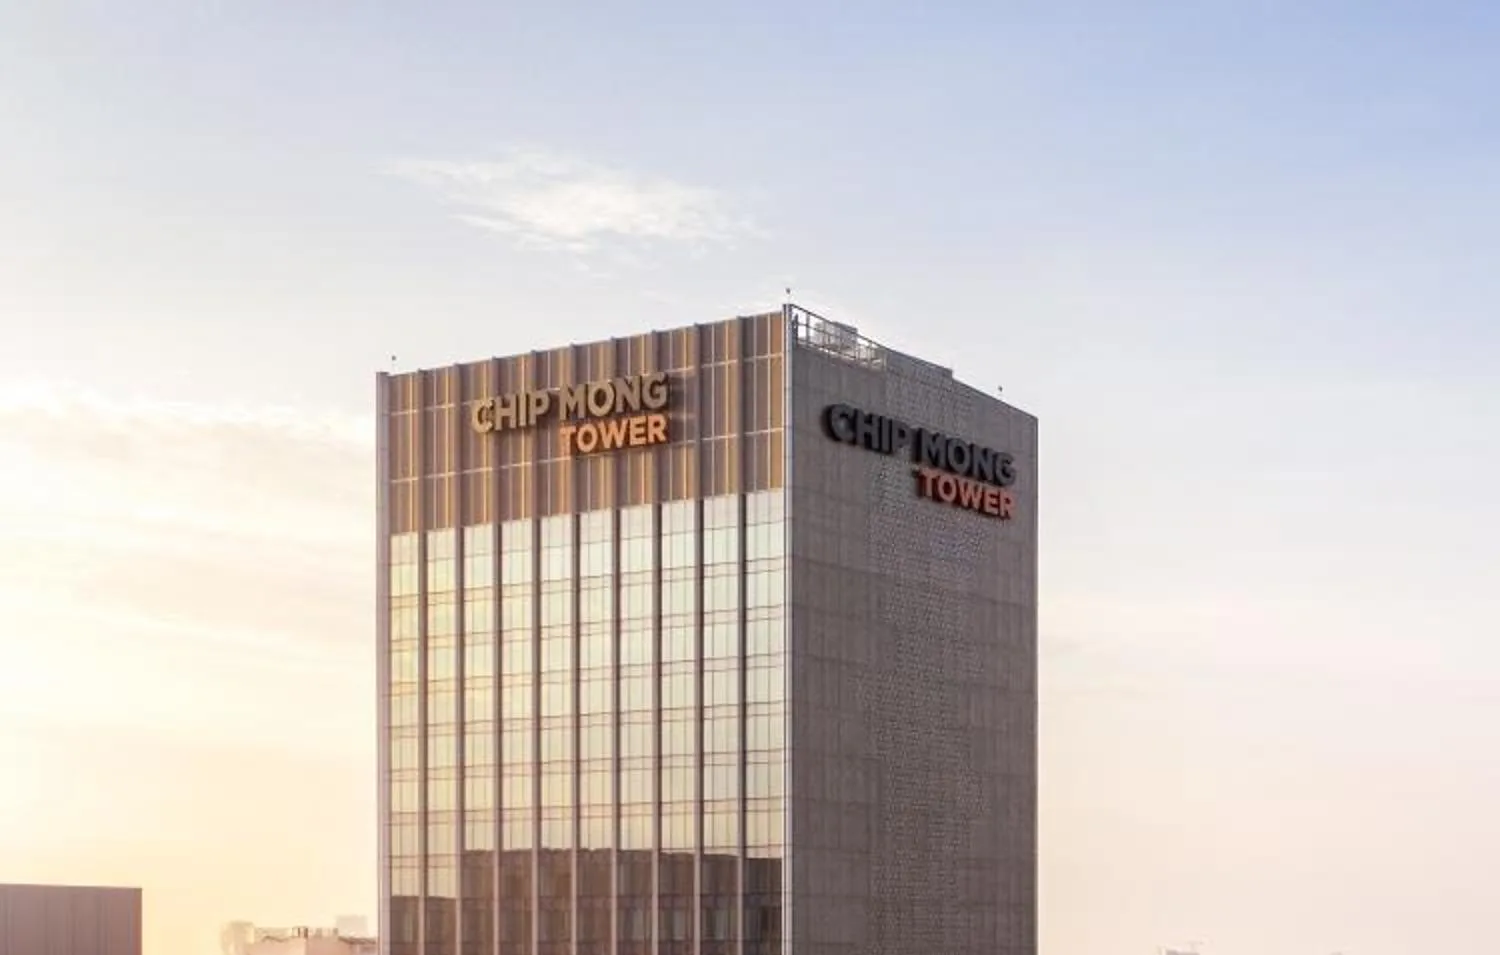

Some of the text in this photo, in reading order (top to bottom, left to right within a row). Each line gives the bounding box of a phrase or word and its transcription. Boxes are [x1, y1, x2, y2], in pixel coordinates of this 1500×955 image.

[470, 371, 669, 433] CHIP MONG
[559, 414, 668, 455] TOWER
[824, 403, 1017, 486] CHIP MONG
[917, 470, 1017, 519] TOWER
